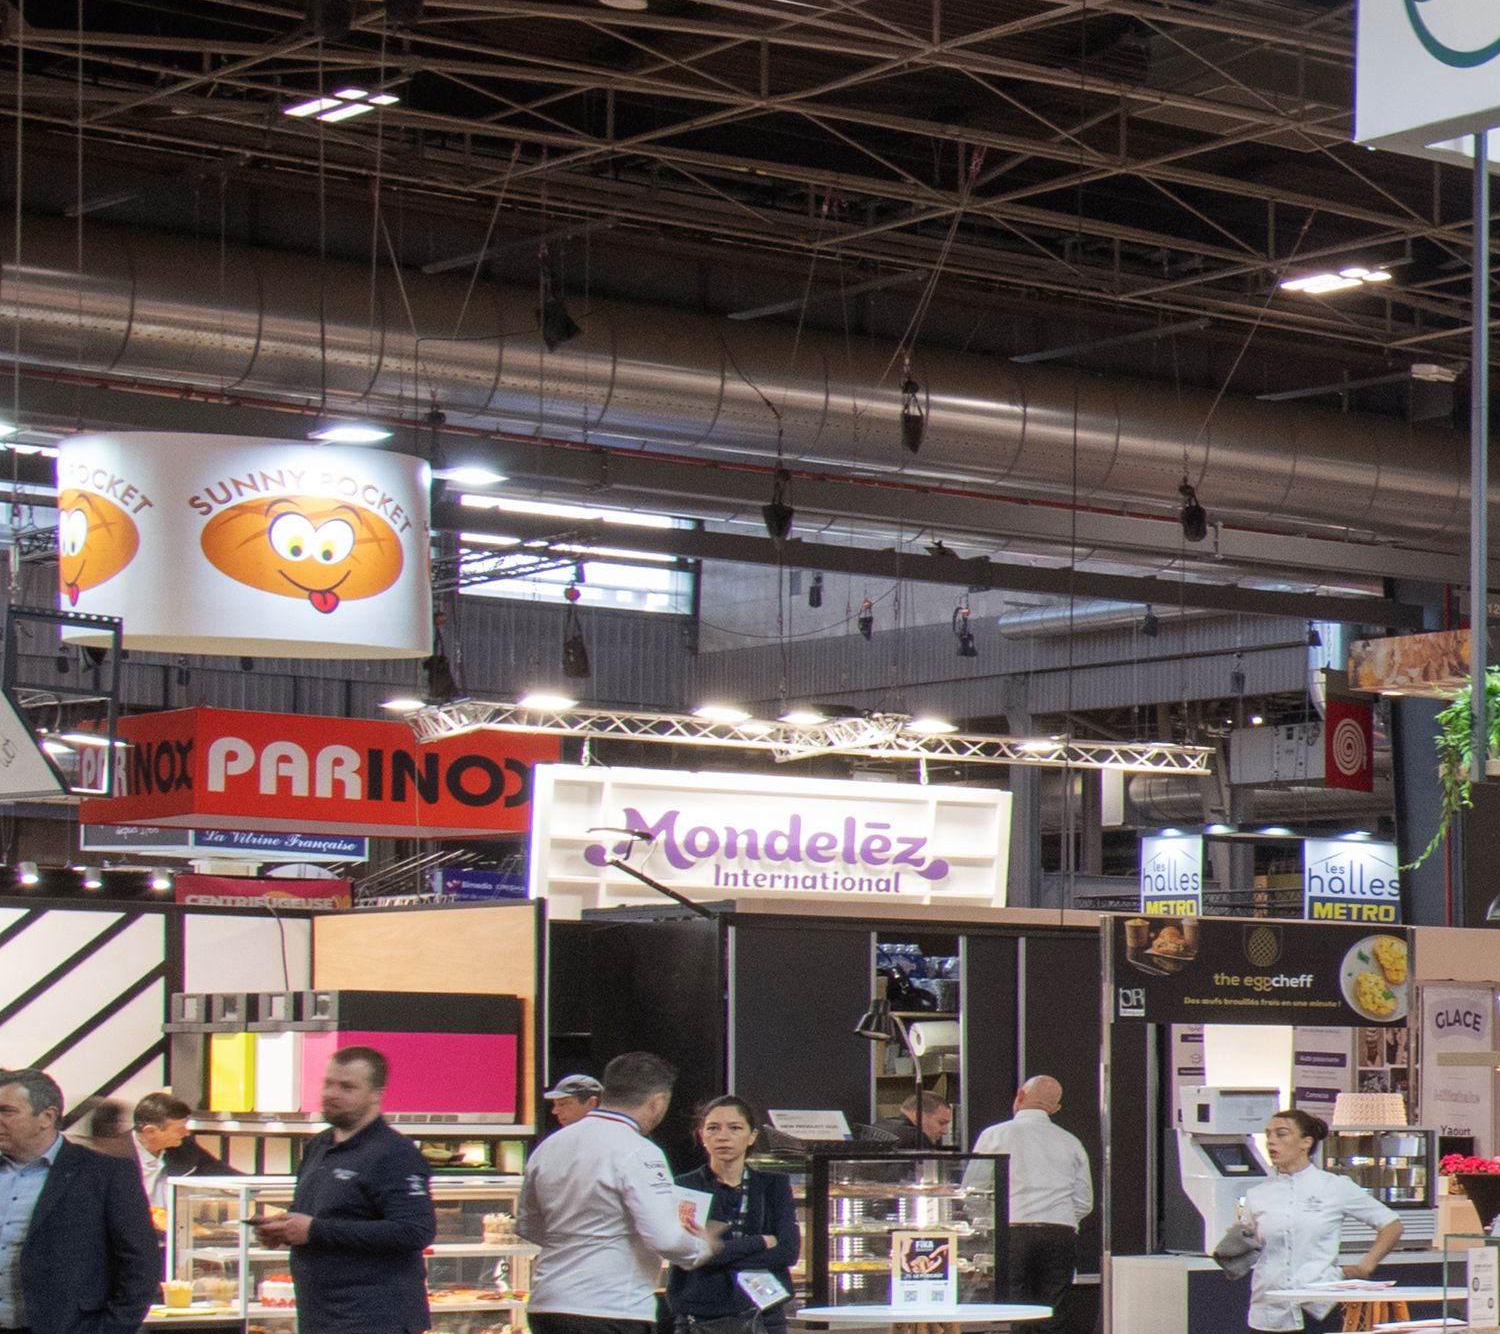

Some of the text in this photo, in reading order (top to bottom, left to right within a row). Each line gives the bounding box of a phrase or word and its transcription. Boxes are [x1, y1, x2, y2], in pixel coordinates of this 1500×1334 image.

[68, 463, 153, 515] OCKET
[189, 468, 306, 515] SUNNY
[1144, 860, 1199, 892] halles
[1154, 862, 1166, 872] les
[1309, 860, 1400, 896] halles
[1326, 862, 1345, 874] les
[714, 864, 901, 894] International
[1146, 900, 1197, 916] METRO
[1313, 902, 1395, 922] METRO
[1214, 973, 1239, 986] the
[1435, 1009, 1482, 1033] GLACE
[1441, 1125, 1471, 1138] Yaourt
